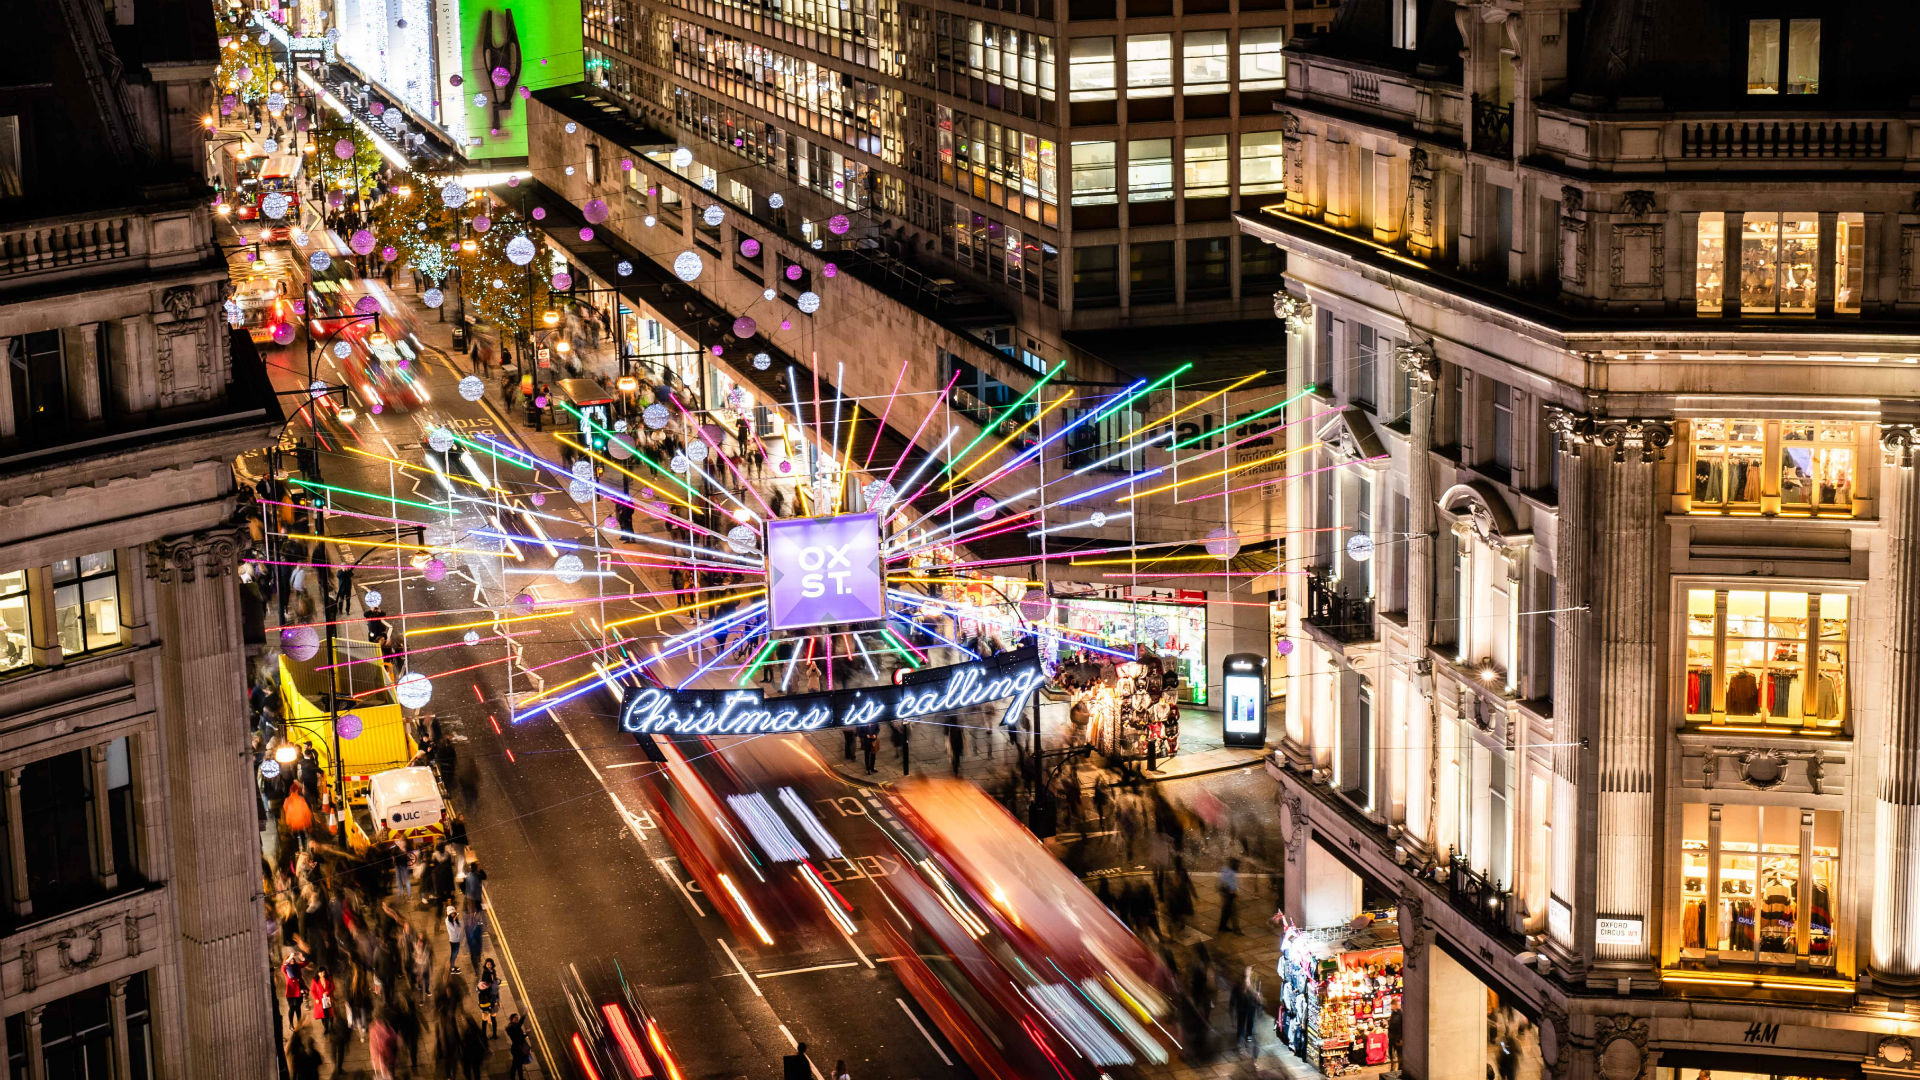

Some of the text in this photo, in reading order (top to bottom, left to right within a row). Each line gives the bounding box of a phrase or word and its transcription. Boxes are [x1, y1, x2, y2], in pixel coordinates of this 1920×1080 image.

[798, 543, 852, 571] OX
[801, 570, 853, 599] ST.
[1164, 641, 1190, 651] SALE
[624, 667, 1046, 733] Christmas is calling
[403, 811, 420, 821] ULC
[1600, 921, 1628, 929] OXFORD
[1600, 928, 1626, 937] CIRCUS
[1744, 1020, 1780, 1045] H&M
